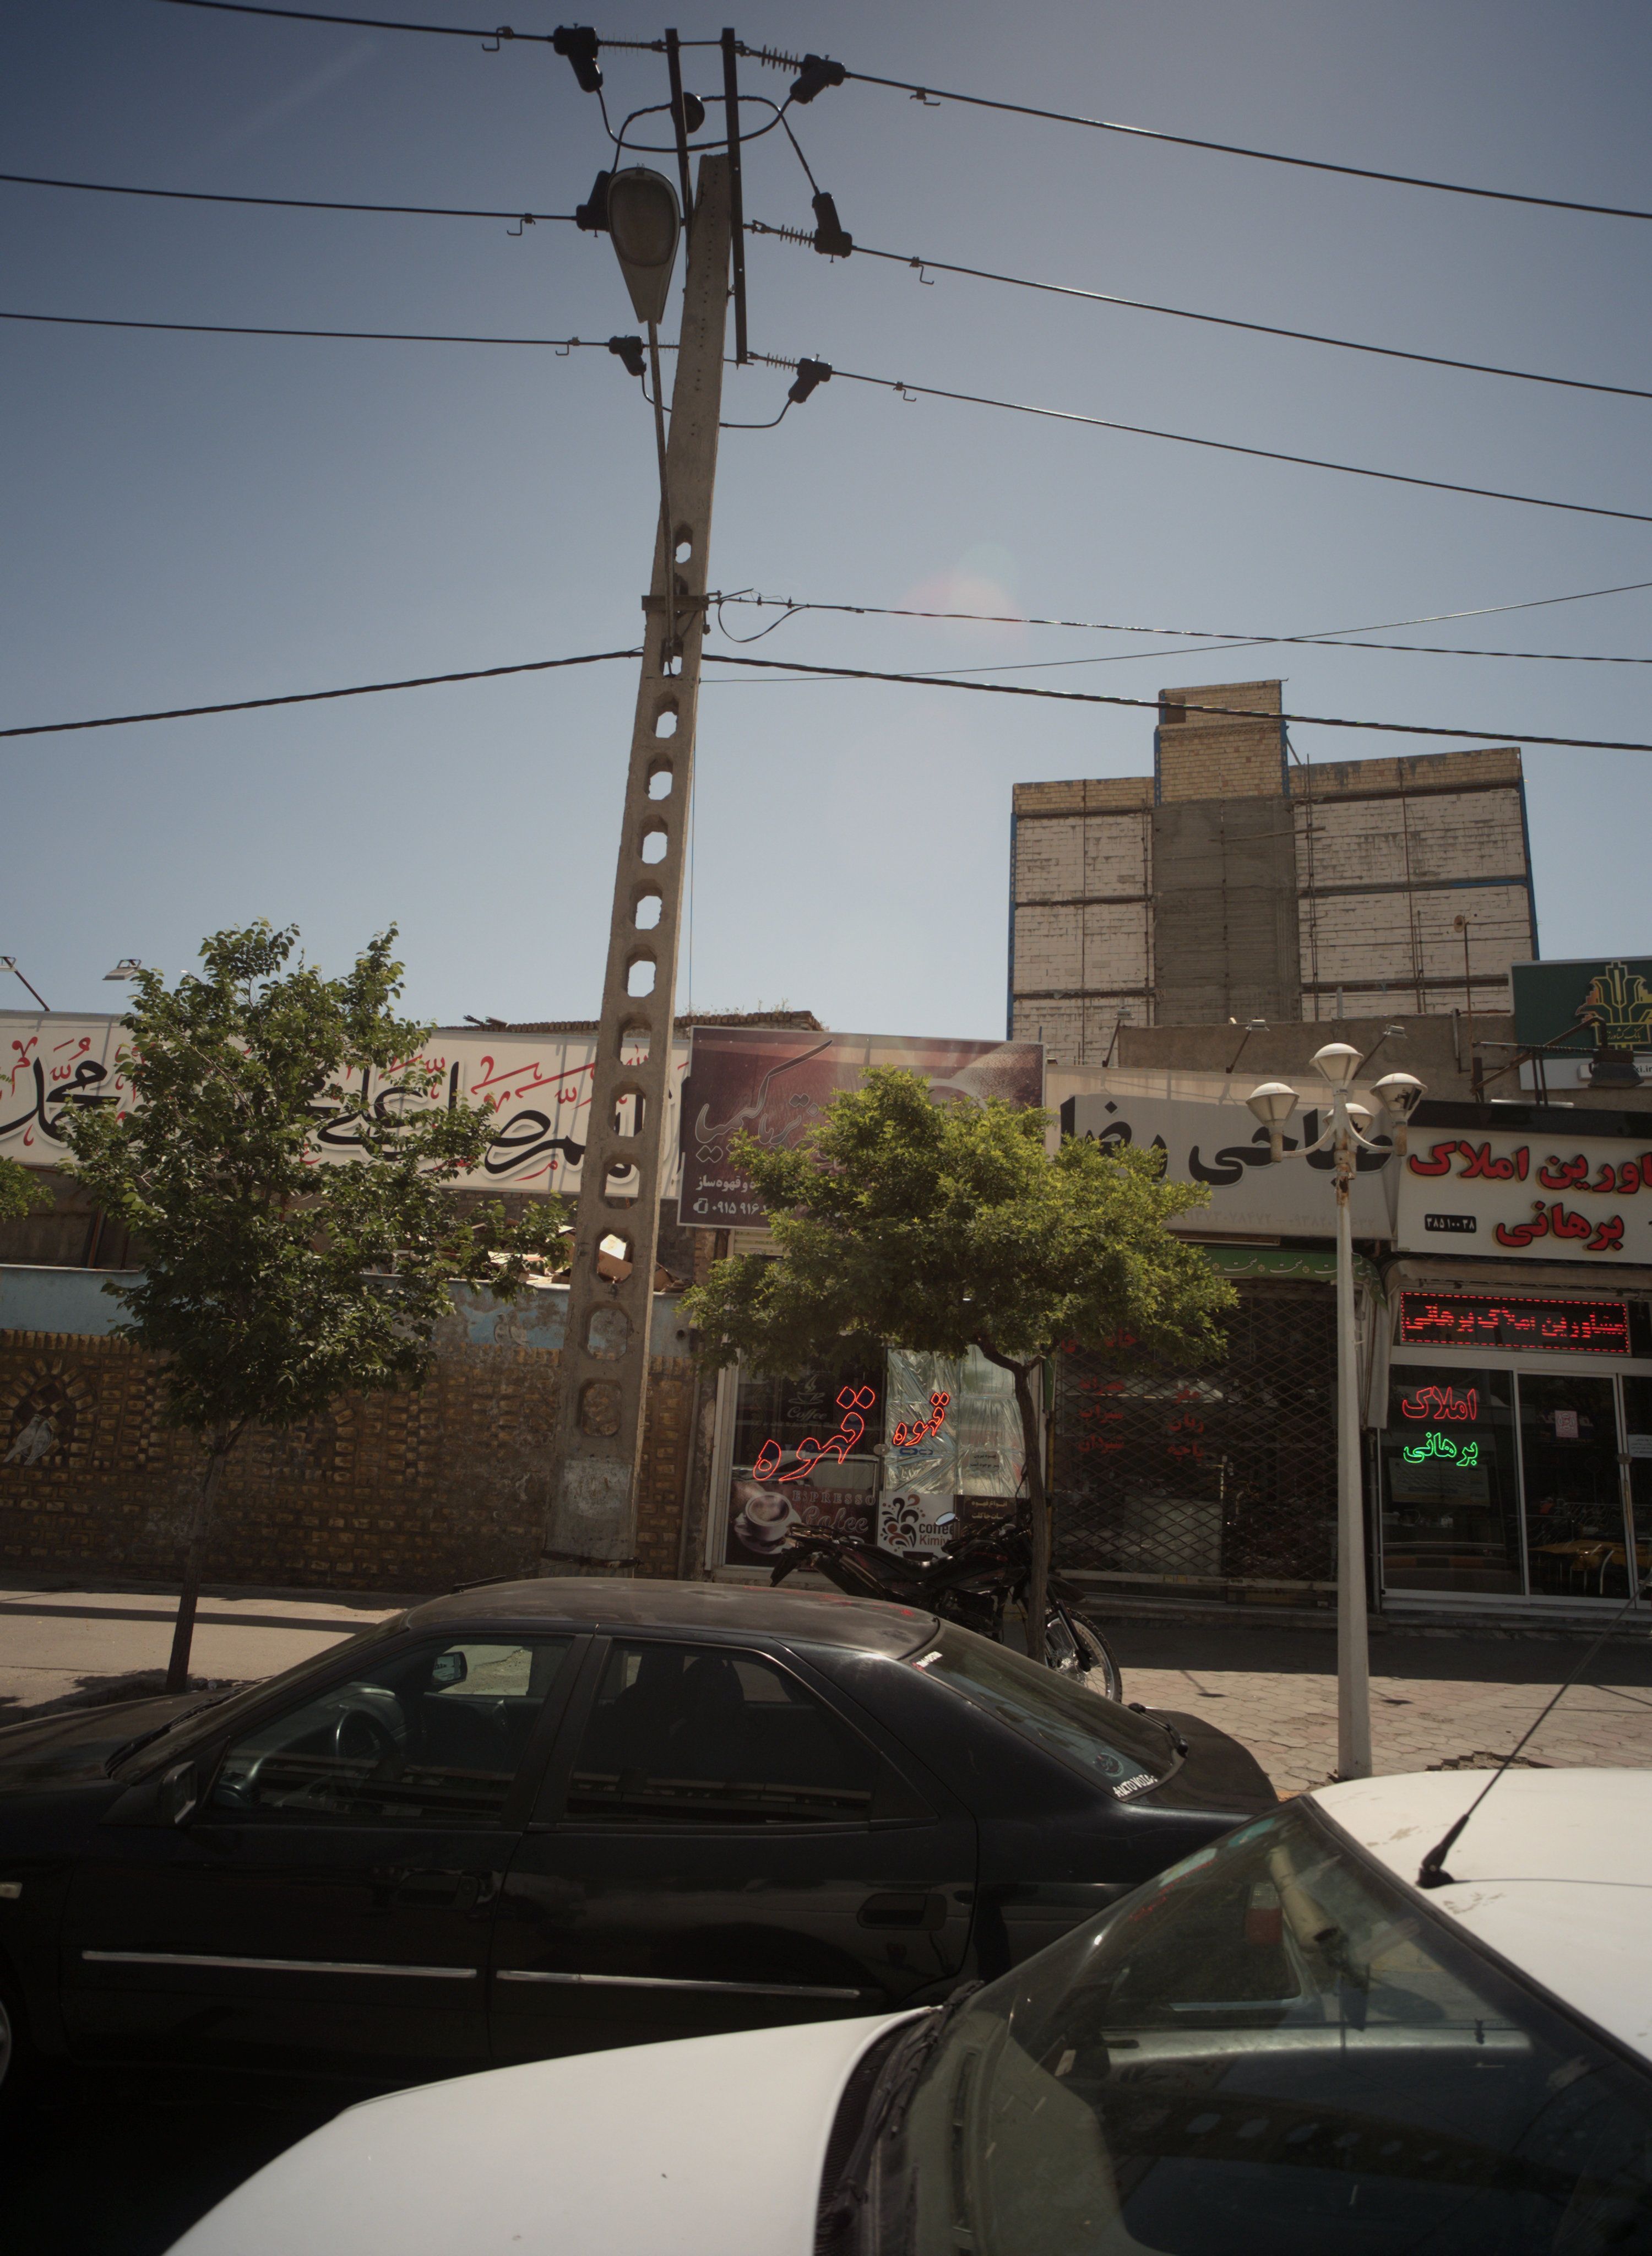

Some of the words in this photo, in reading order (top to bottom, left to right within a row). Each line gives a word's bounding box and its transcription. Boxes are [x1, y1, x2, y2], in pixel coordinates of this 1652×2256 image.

[1607, 1025, 1632, 1040] کشاورز
[1408, 1140, 1530, 1181] املاک
[1539, 1150, 1652, 1194] اورین
[1496, 1200, 1625, 1252] برهانی
[786, 1406, 828, 1422] Coffee
[893, 1391, 950, 1447] قهوه
[1402, 1385, 1477, 1420] املاک
[753, 1385, 876, 1482] قهوه
[1403, 1431, 1479, 1467] برهانی
[919, 1536, 949, 1546] Kimiy
